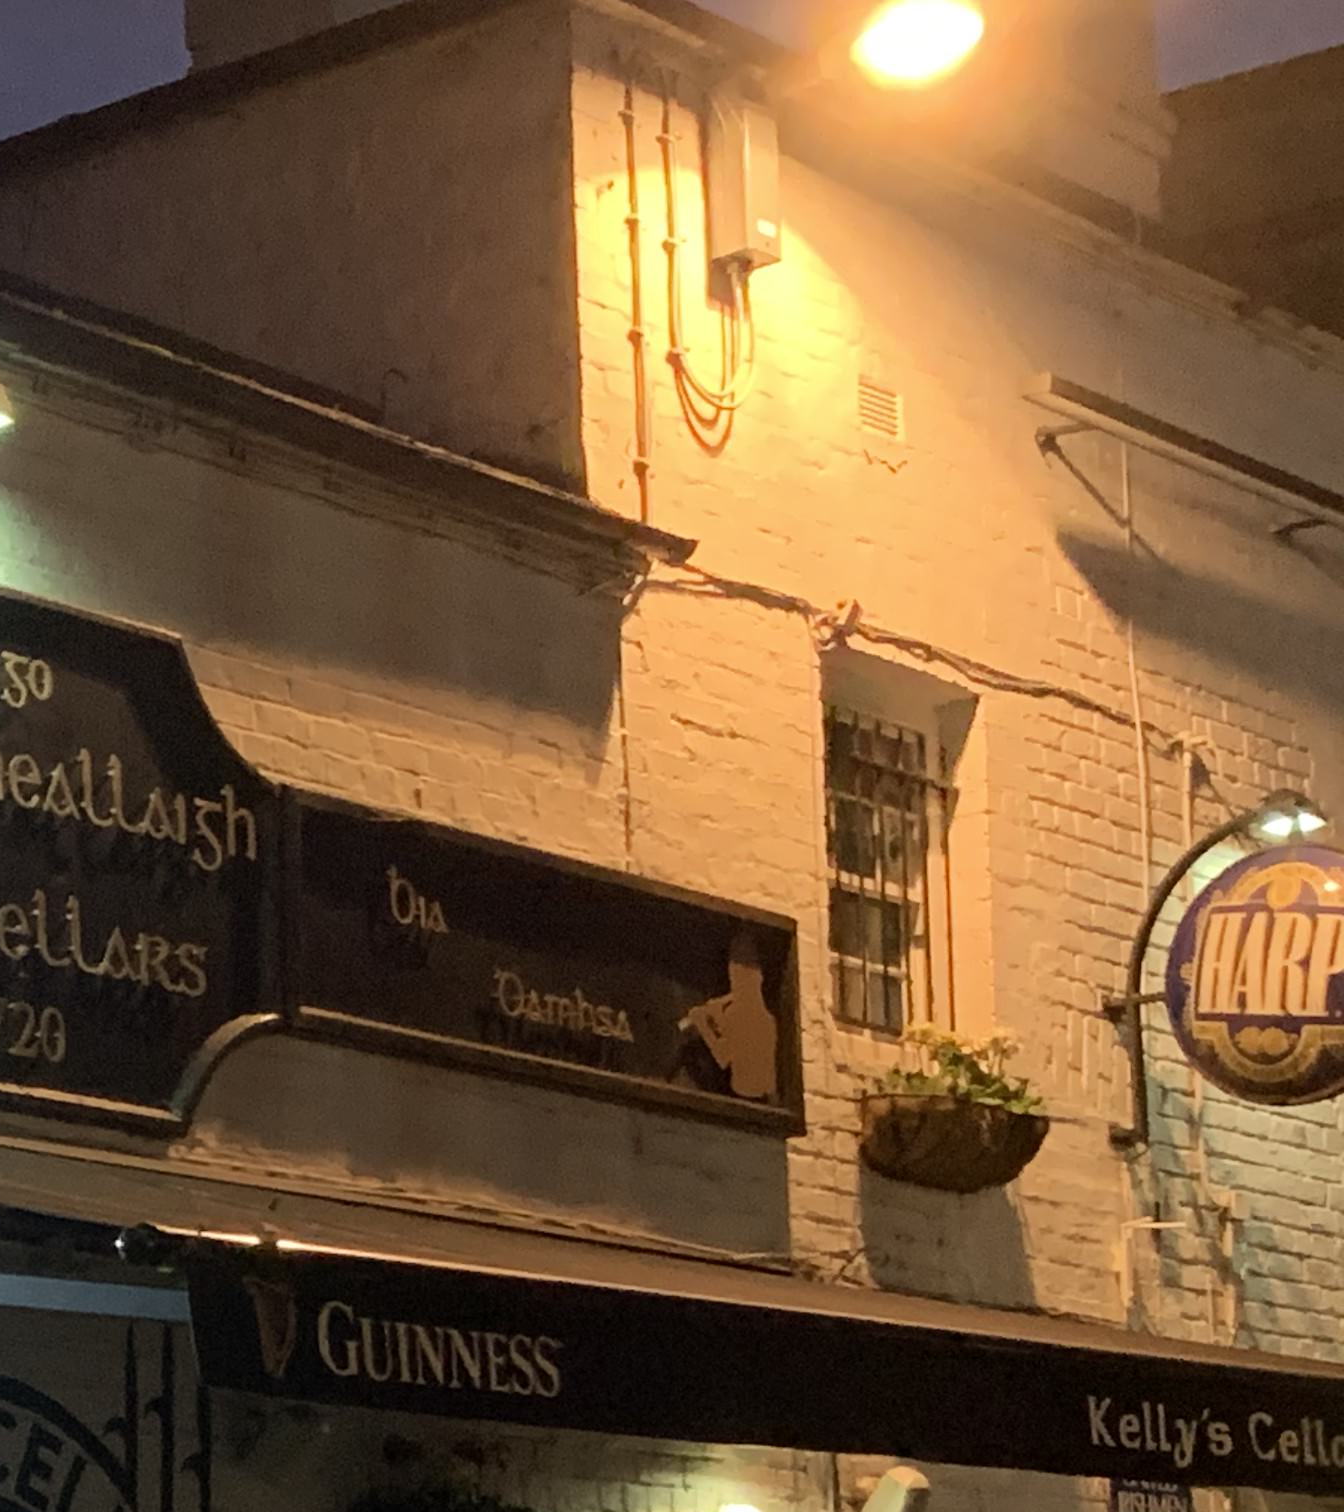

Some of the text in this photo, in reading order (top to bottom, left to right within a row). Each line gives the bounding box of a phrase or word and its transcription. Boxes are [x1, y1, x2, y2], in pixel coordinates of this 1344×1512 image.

[1197, 909, 1344, 1017] HARP
[317, 1300, 564, 1398] GUINNESS
[1087, 1395, 1234, 1468] Kelly's
